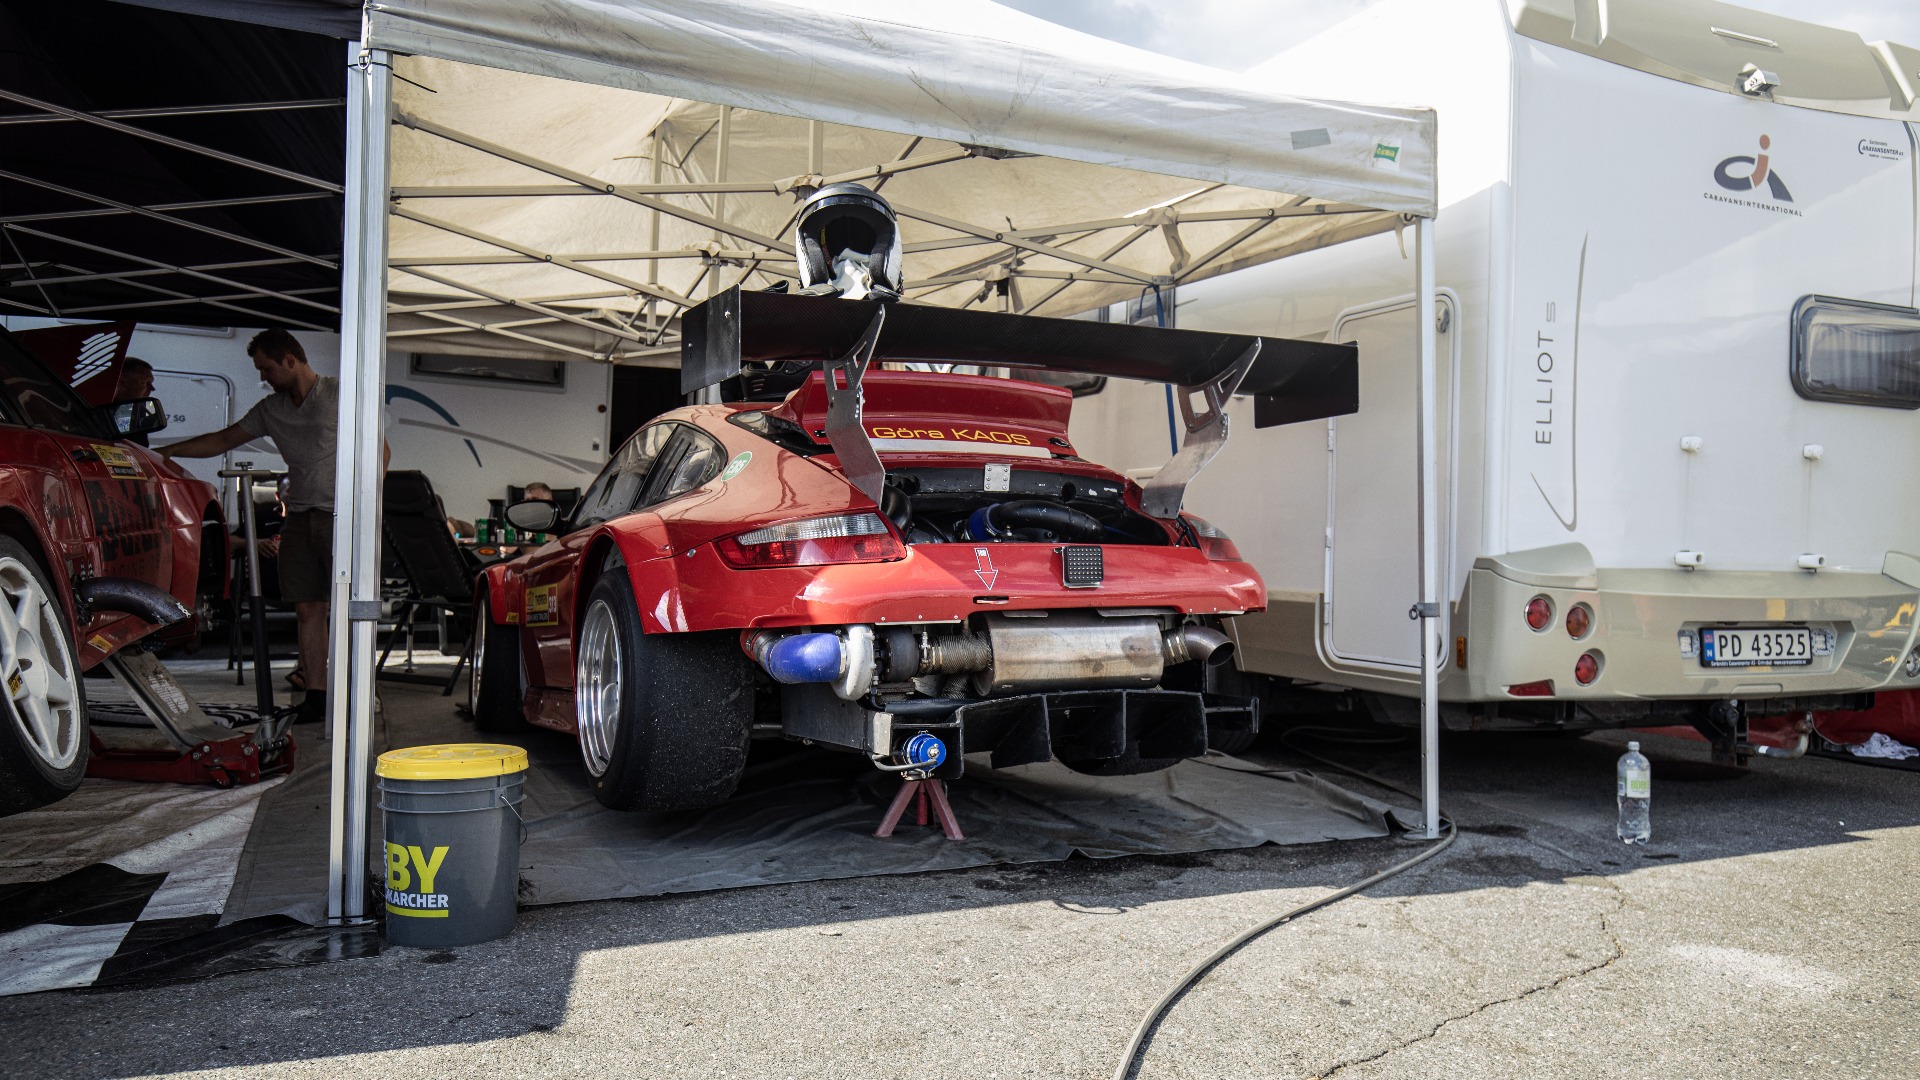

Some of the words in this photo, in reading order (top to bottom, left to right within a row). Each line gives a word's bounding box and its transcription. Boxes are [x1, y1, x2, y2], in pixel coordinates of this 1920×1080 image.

[1535, 330, 1554, 445] ELLIOT
[173, 414, 186, 423] SG
[872, 427, 944, 440] Göra
[951, 428, 1031, 446] KAOS
[1706, 650, 1713, 658] N
[1718, 634, 1742, 658] PD
[1751, 633, 1806, 657] 43525
[387, 842, 450, 894] BY
